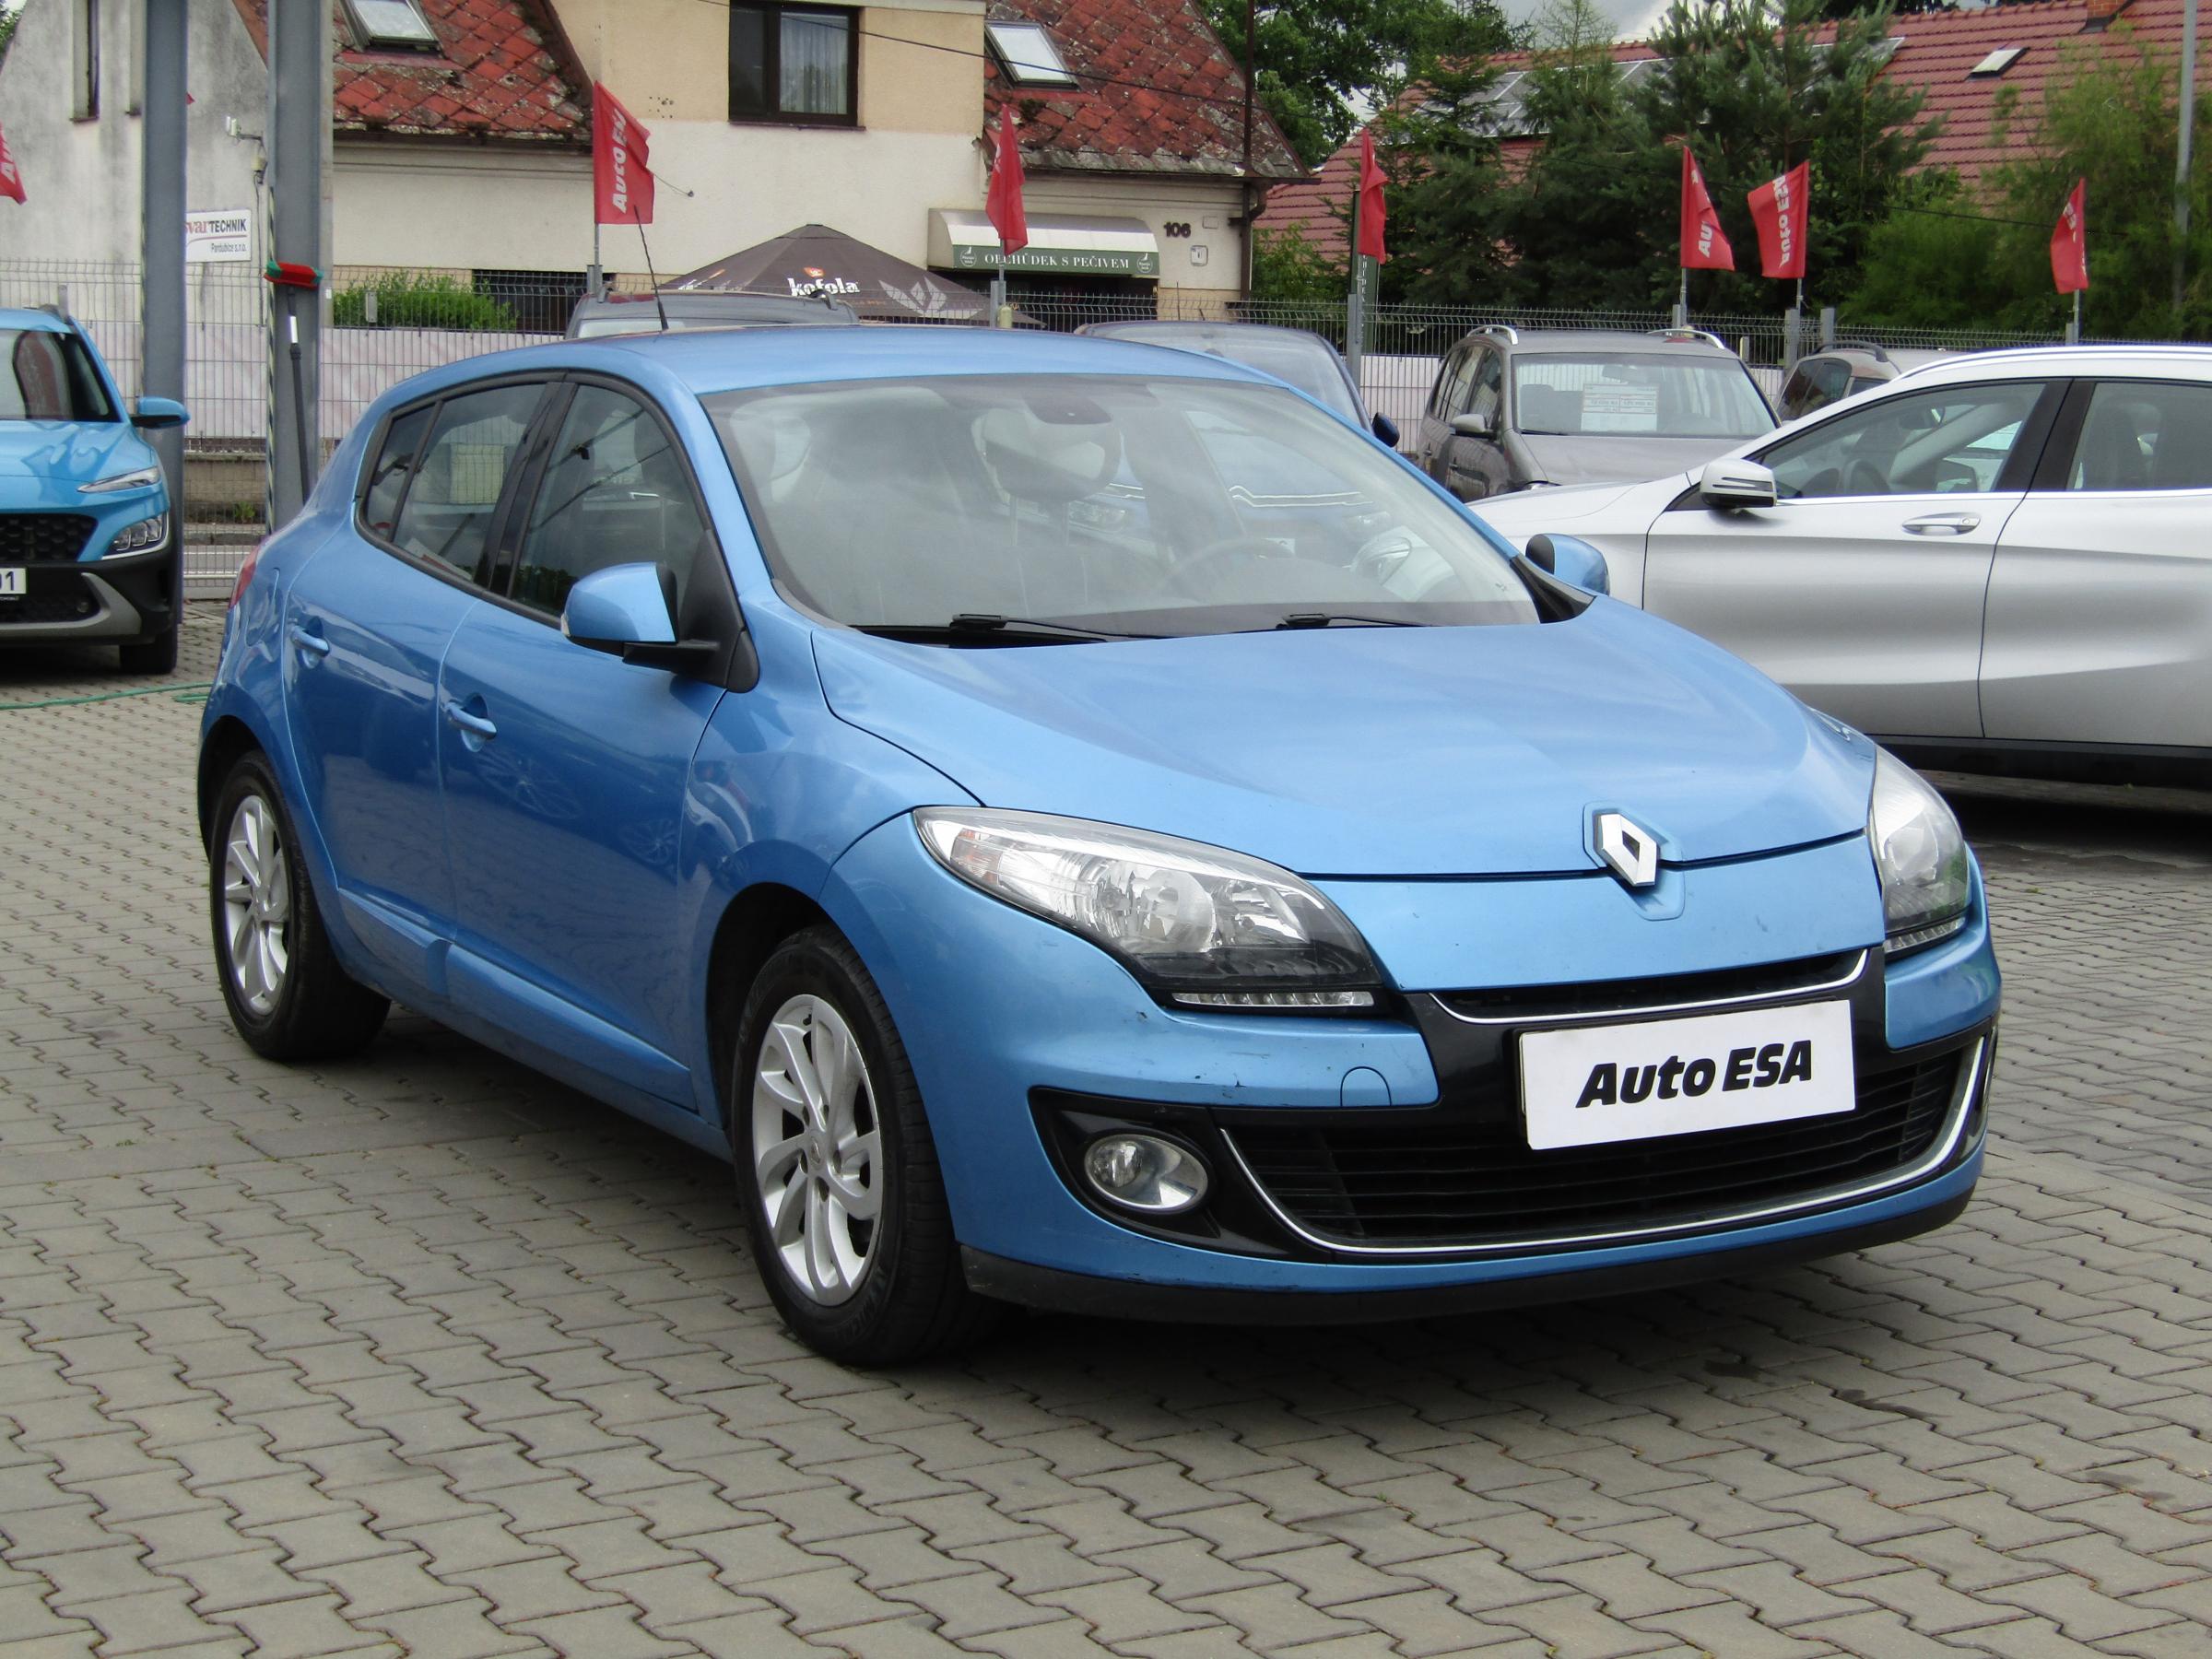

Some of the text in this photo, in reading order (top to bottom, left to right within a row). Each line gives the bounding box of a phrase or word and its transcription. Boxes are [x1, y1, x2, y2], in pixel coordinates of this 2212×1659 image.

[1163, 222, 1191, 237] 106
[1062, 256, 1069, 266] S
[1073, 255, 1129, 268] PEČIVEM
[0, 571, 15, 591] 1
[1575, 1040, 1812, 1108] Auto ESA
